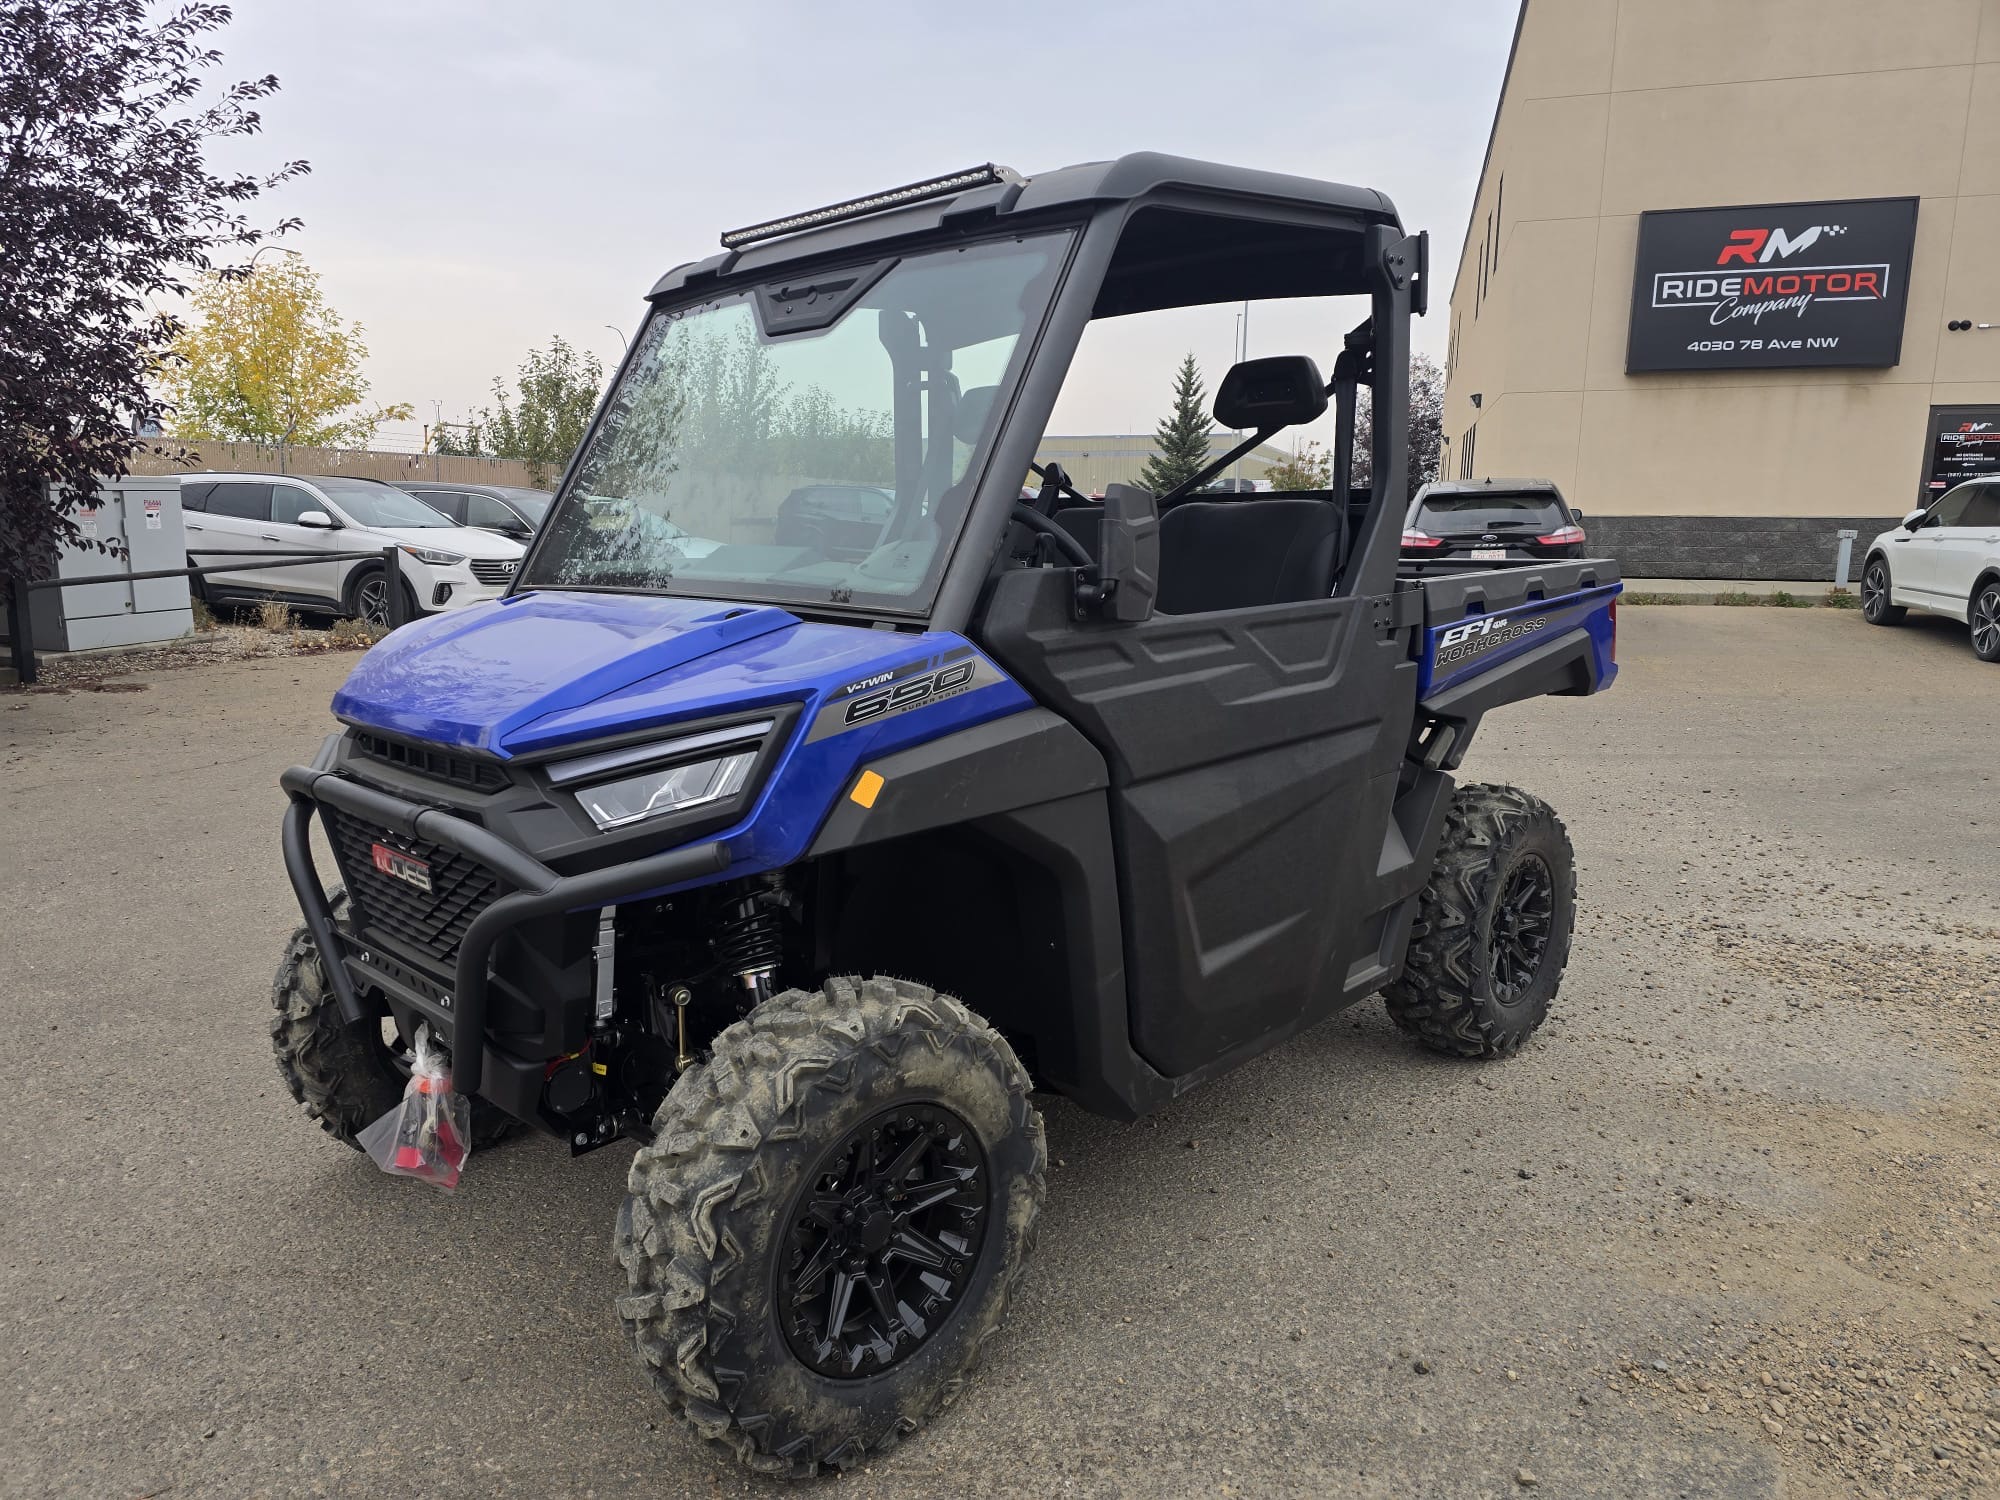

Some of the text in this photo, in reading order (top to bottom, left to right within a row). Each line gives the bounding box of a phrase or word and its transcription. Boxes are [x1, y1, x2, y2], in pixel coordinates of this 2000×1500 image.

[1717, 226, 1822, 265] RM
[1662, 272, 1882, 299] RIDEMOTOR
[1709, 294, 1813, 326] Company
[1687, 337, 1839, 352] 4030 78 Ave NW
[1958, 422, 1988, 432] RM
[1434, 617, 1547, 669] WORKCROSS
[1440, 617, 1494, 649] EFI
[843, 659, 975, 726] 650
[846, 671, 894, 695] V-TWIN
